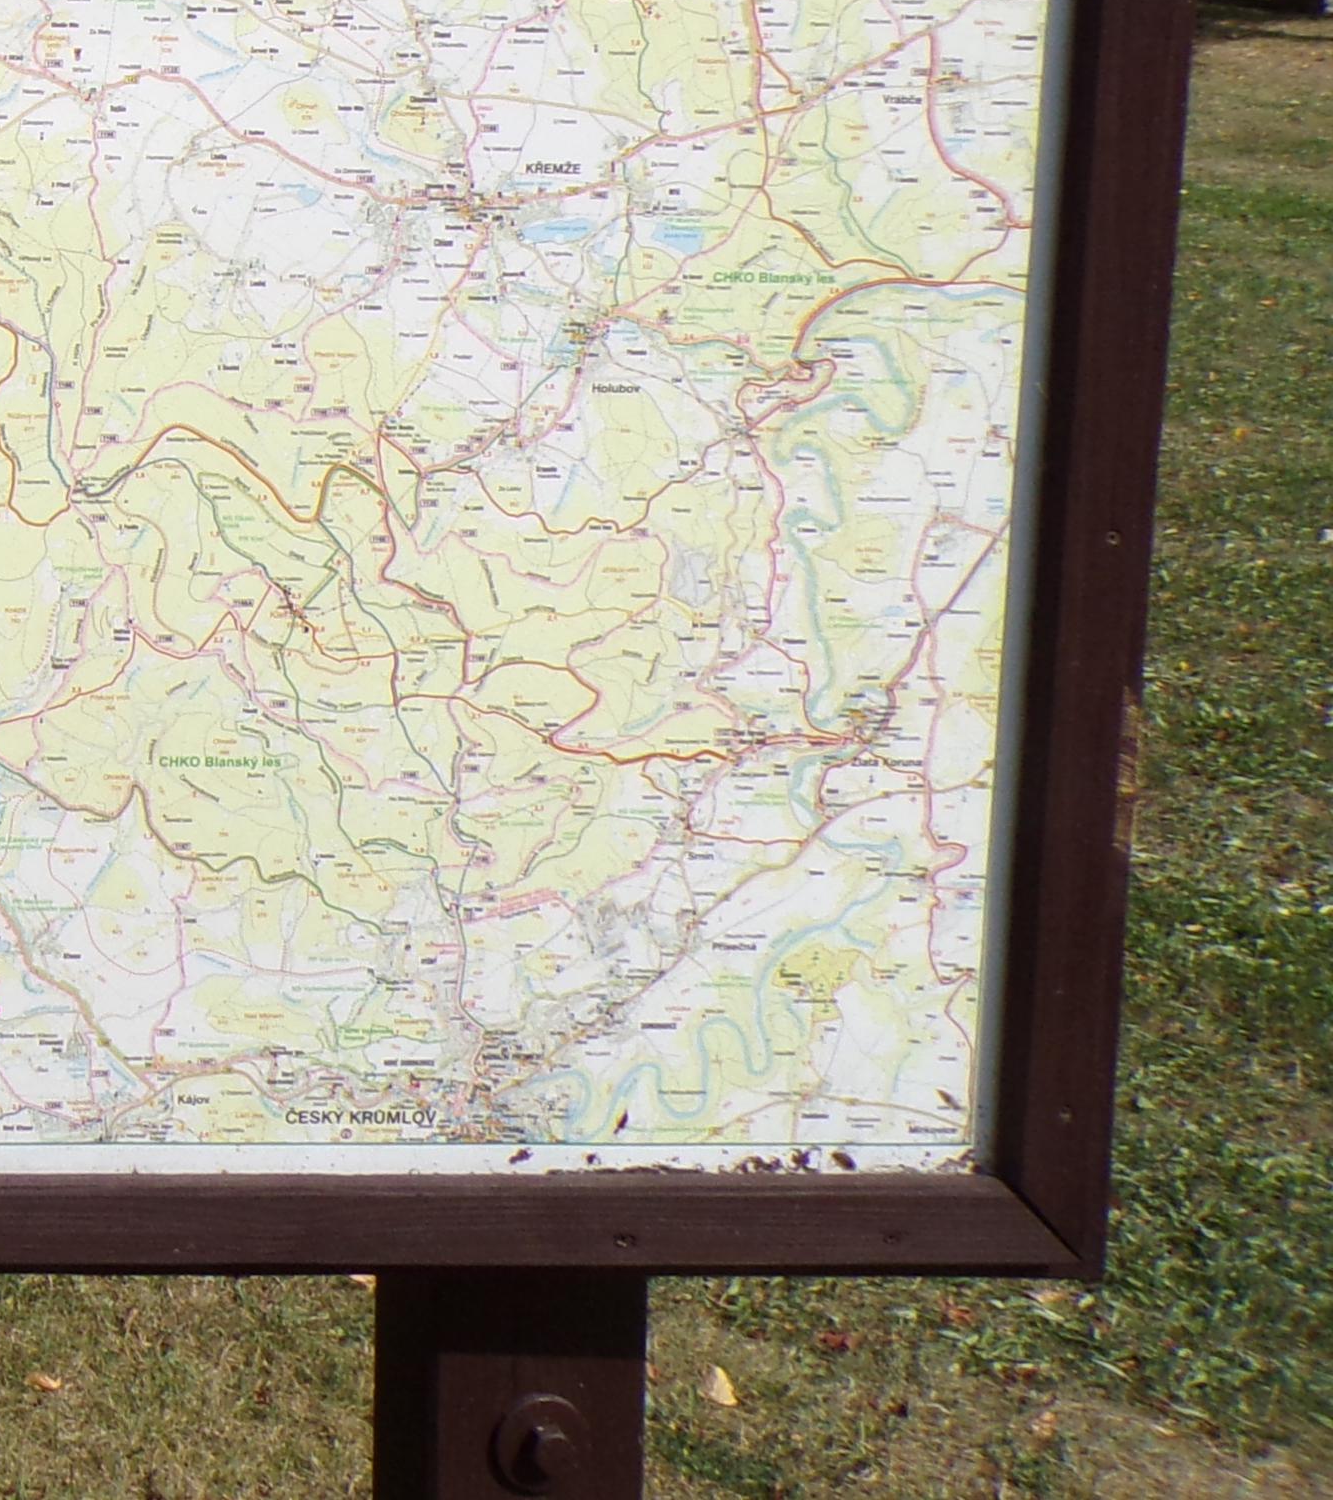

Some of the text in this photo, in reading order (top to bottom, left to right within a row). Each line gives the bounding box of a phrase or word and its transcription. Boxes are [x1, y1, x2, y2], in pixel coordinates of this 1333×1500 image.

[525, 161, 581, 174] KŘEMŽE
[712, 270, 835, 285] CHKO Blanský les
[592, 383, 640, 393] Holubov
[158, 755, 280, 769] CHKO Blanský les
[177, 1094, 210, 1107] Kájov
[285, 1107, 437, 1125] ČESKÝ KRUMLOV
